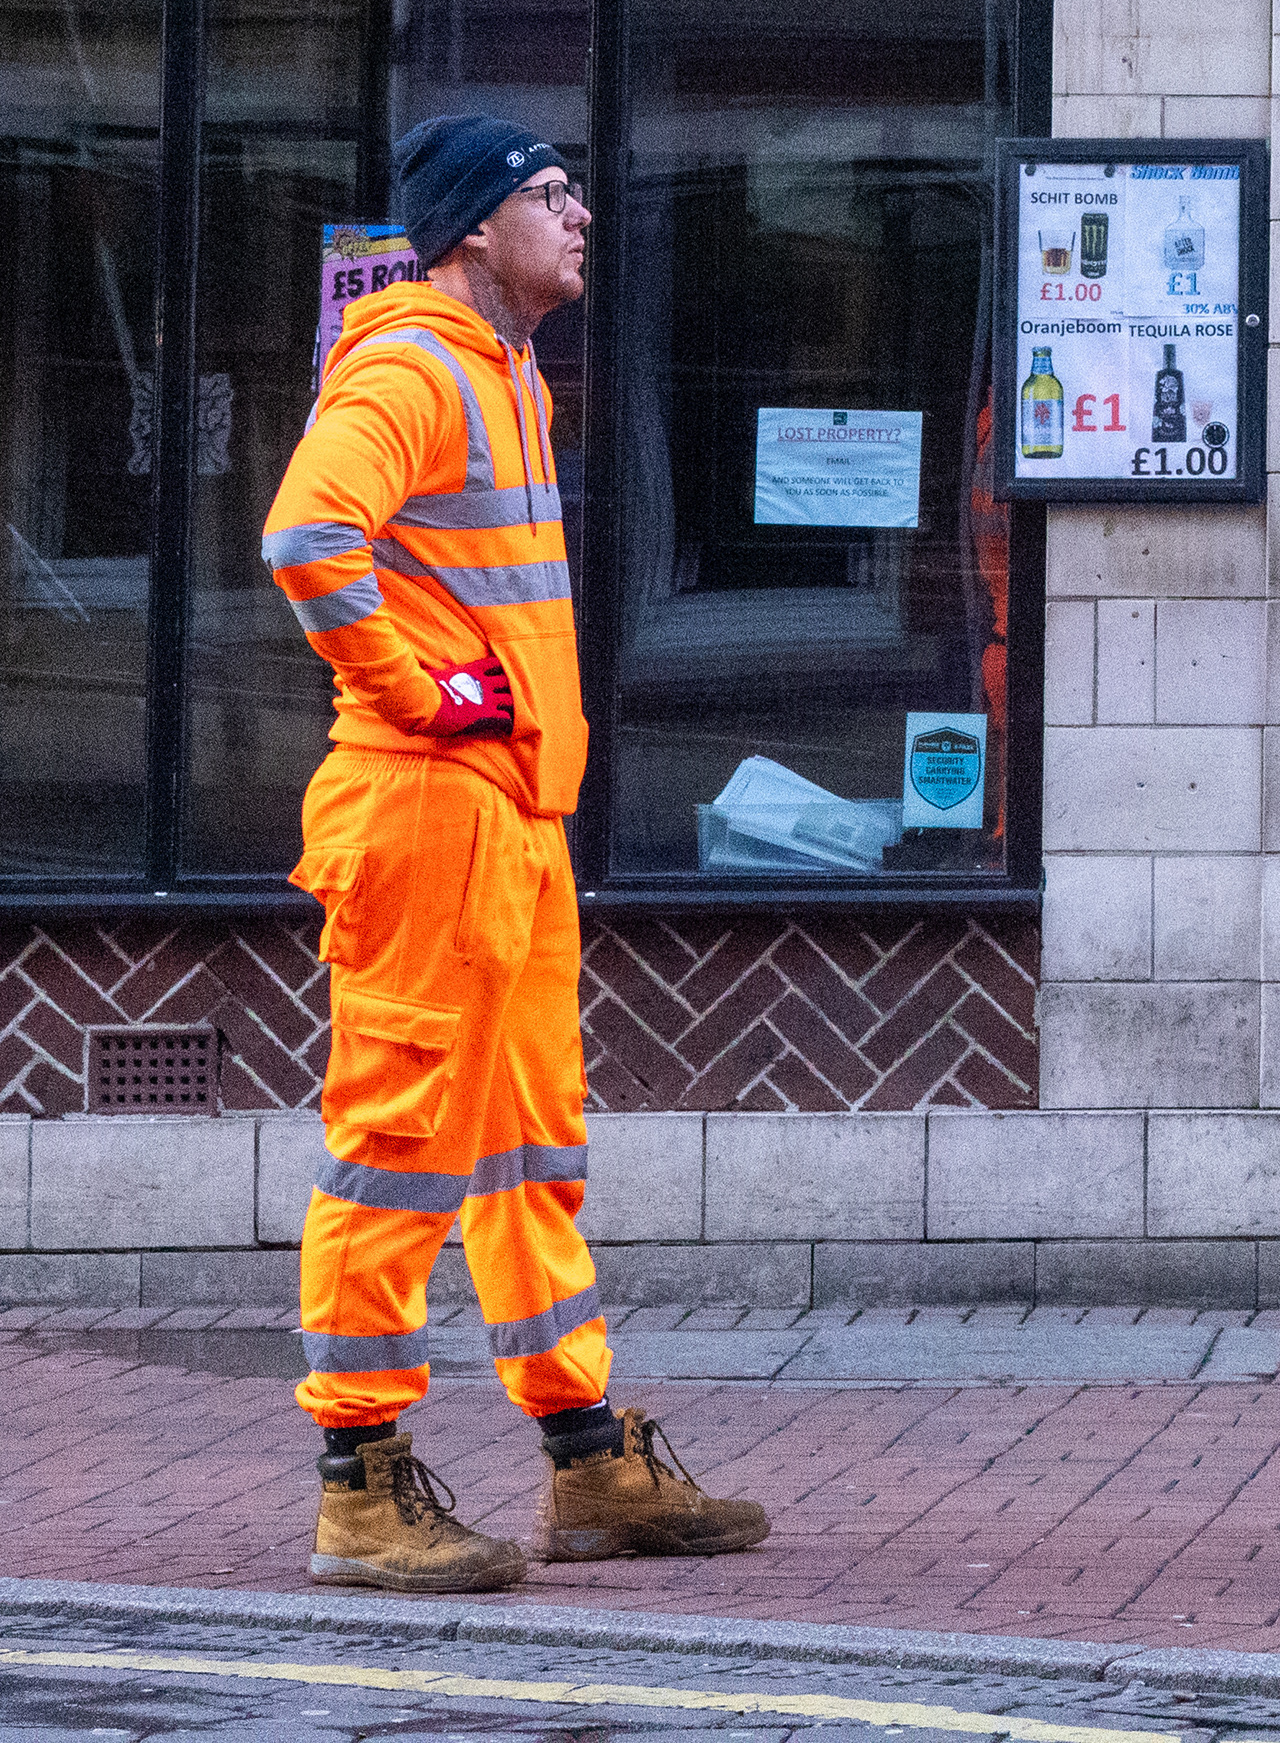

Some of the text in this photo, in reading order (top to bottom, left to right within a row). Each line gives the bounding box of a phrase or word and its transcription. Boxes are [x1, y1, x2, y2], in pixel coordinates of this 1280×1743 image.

[1030, 192, 1118, 205] SCHIT BOMB
[332, 267, 365, 301] £5
[1040, 283, 1102, 302] £1.00
[1166, 272, 1201, 296] £1
[1182, 303, 1209, 314] 30%
[1020, 319, 1122, 337] Oranjeboom
[1129, 324, 1233, 339] TEQUILA ROSE
[1072, 393, 1127, 432] £1
[778, 427, 901, 444] LOST PROPERTY?
[1131, 447, 1228, 476] £1.00
[791, 477, 831, 486] SOMEONE
[853, 478, 870, 486] GET
[872, 478, 892, 486] BACK
[803, 488, 814, 496] AS
[815, 488, 839, 496] SOON
[840, 488, 850, 496] AS
[853, 488, 889, 497] POSSIBLE
